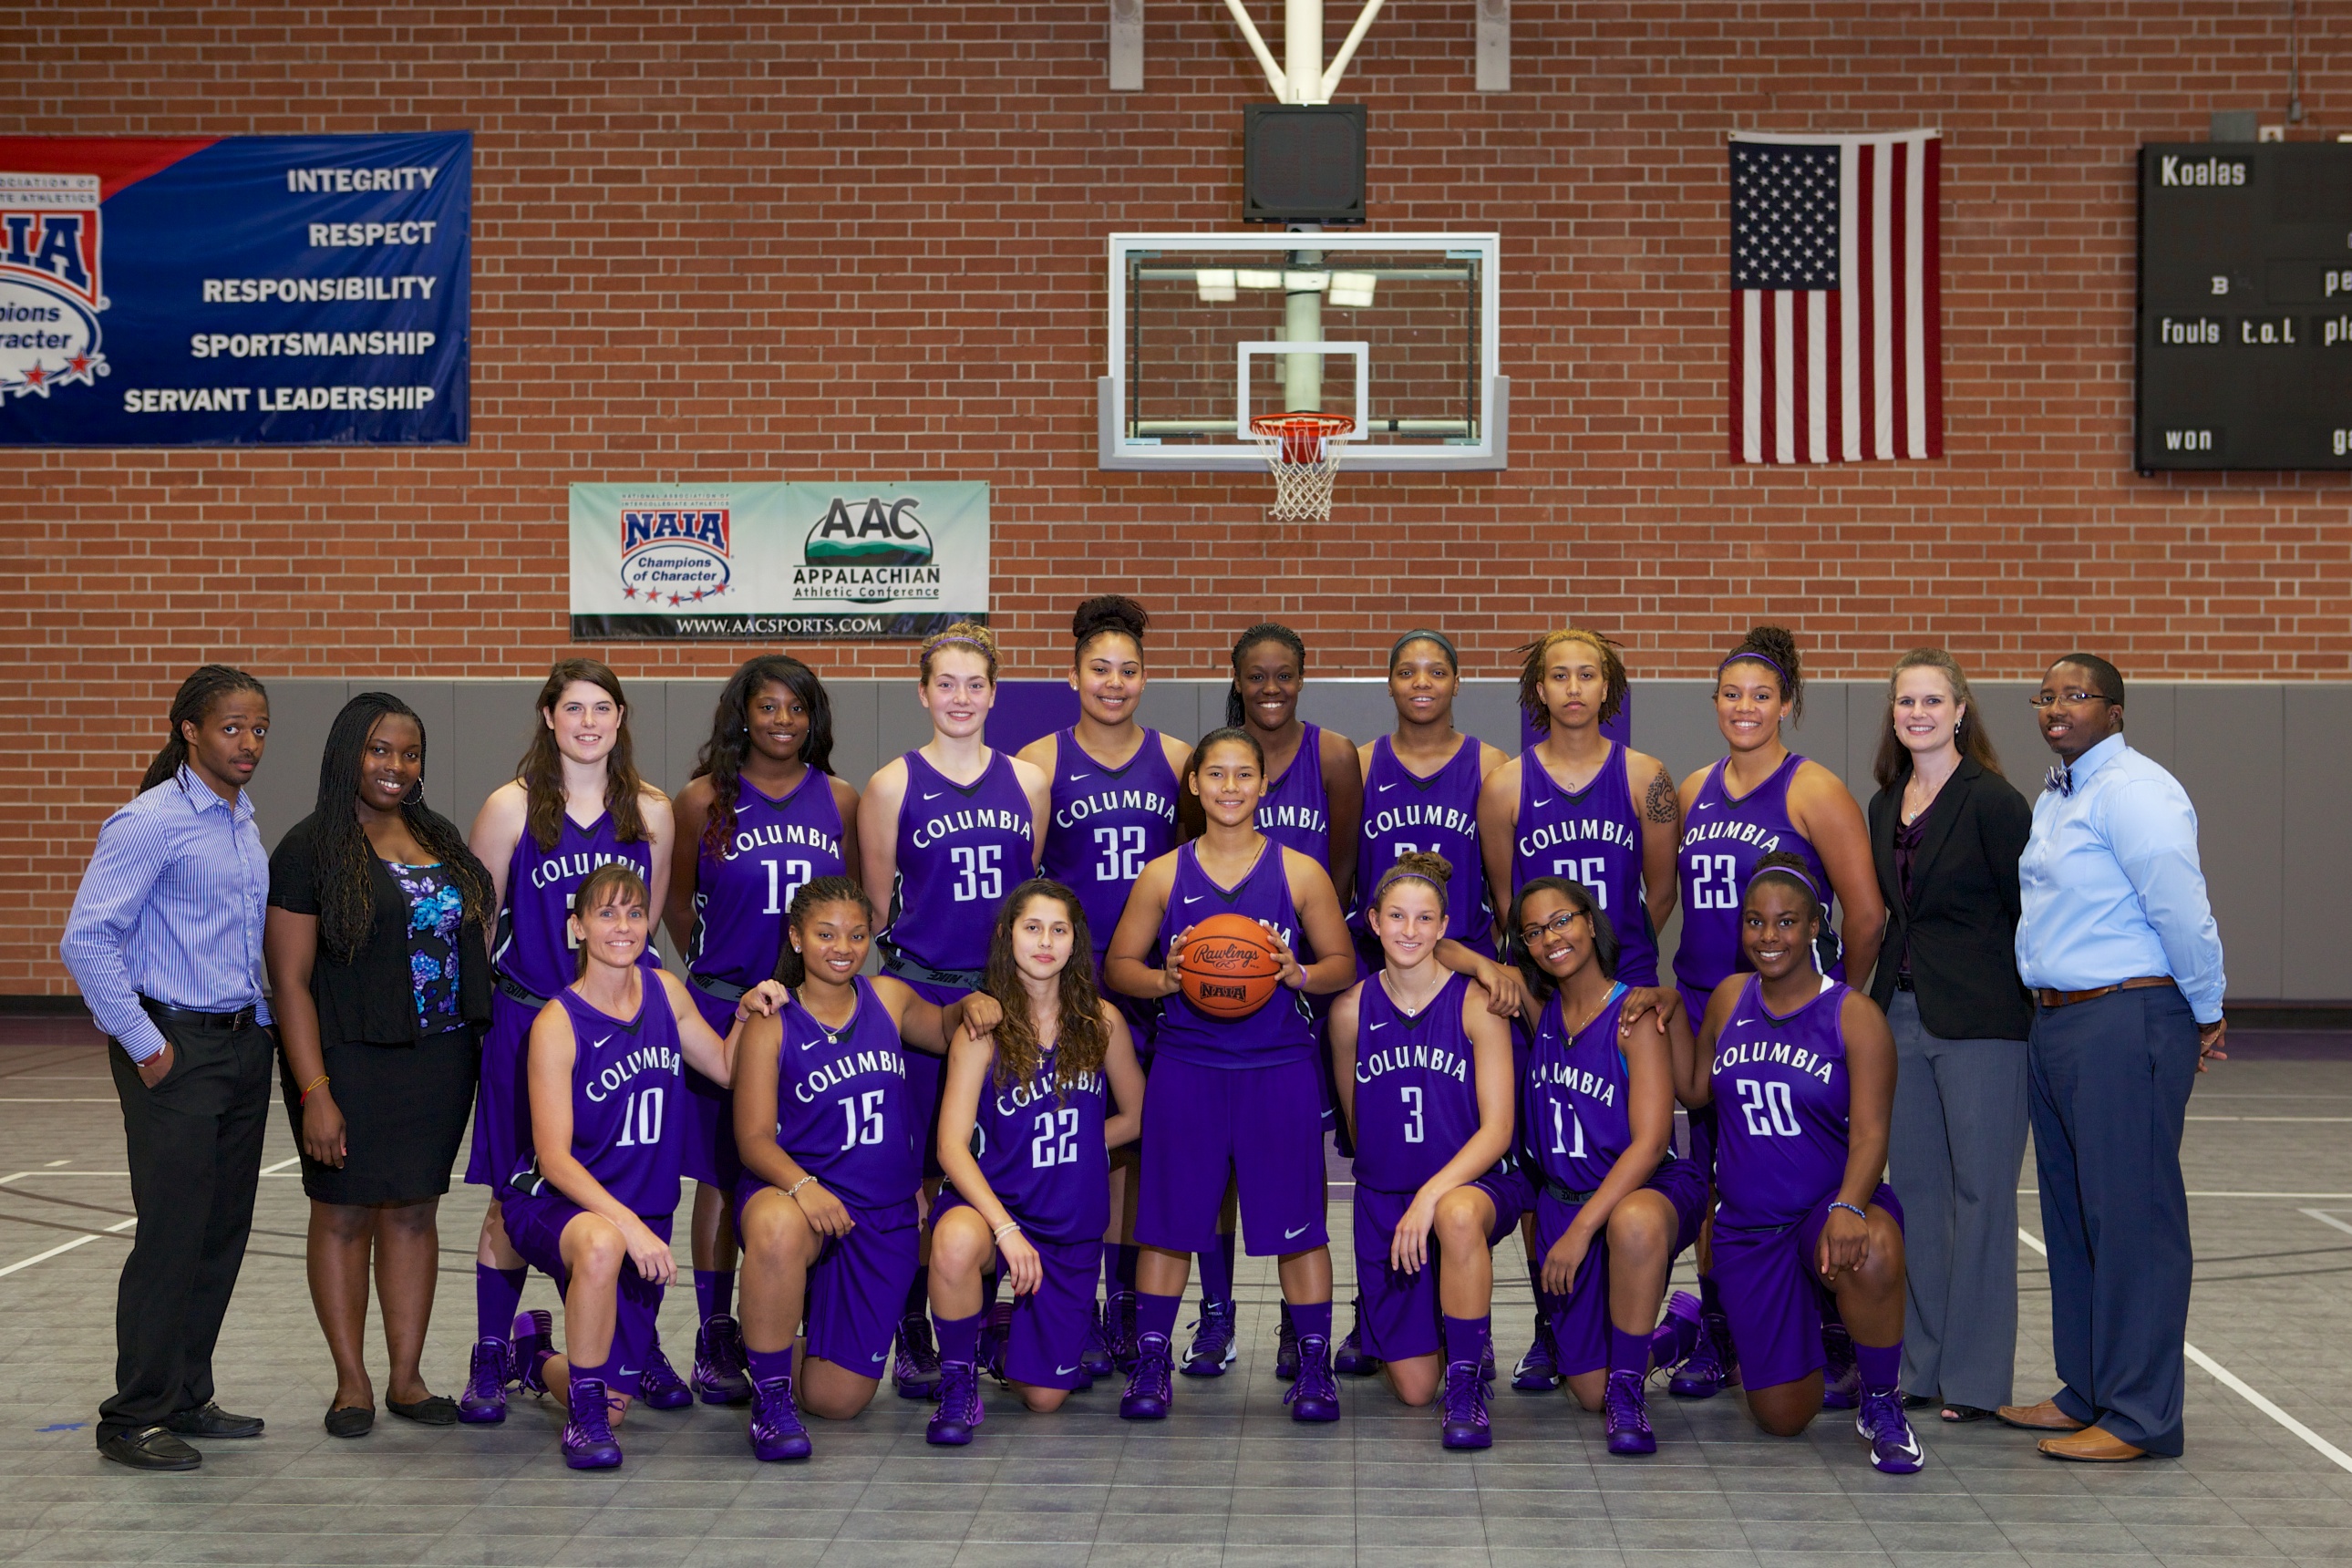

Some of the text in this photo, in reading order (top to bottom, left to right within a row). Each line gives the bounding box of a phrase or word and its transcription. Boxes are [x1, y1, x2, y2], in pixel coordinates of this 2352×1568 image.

[287, 167, 438, 192] INTEGRITY
[2161, 156, 2246, 186] Koalas
[20, 192, 96, 203] ATHLETICS
[309, 221, 438, 247] RESPECT
[0, 216, 89, 294] IA
[203, 275, 438, 303] RESPONSIBILITY
[2211, 276, 2229, 294] B
[191, 331, 437, 358] SPORTSMANSHIP
[2161, 318, 2221, 344] fouls
[2242, 318, 2295, 344] t.o.l.
[124, 386, 437, 414] SERVANT LEADERSHIP
[2165, 430, 2213, 450] won
[624, 511, 727, 552] NAIA
[820, 498, 920, 540] AAC
[633, 570, 717, 581] of Character
[638, 557, 712, 570] Champions
[793, 568, 940, 584] APPALACHIAN
[794, 585, 940, 599] Athletic Conference
[676, 618, 882, 634] WWW.AACSPORTS.COM
[1057, 789, 1176, 829] COLUMBIA
[1364, 804, 1476, 840] COLUMBIA
[722, 824, 840, 861] COLUMBIA
[913, 809, 1032, 849] COLUMBIA
[1518, 819, 1635, 857] COLUMBIA
[1093, 825, 1147, 882] 32
[760, 859, 812, 914] 12
[950, 844, 1003, 902] 35
[1691, 854, 1739, 909] 23
[1193, 943, 1260, 968] Rawlings
[504, 982, 528, 1000] NIKE
[926, 969, 964, 985] NIKE
[1201, 982, 1246, 1003] NAIA
[585, 1046, 681, 1103] COLUMBA
[795, 1050, 906, 1104] COLUMBIA
[1356, 1045, 1467, 1084] COLUMBIA
[1712, 1041, 1833, 1085] COLUMBIA
[615, 1087, 665, 1147] 10
[837, 1088, 885, 1151] 15
[1400, 1086, 1424, 1143] 3
[1736, 1078, 1802, 1137] 20
[1031, 1108, 1079, 1169] 22
[1549, 1097, 1588, 1159] 11
